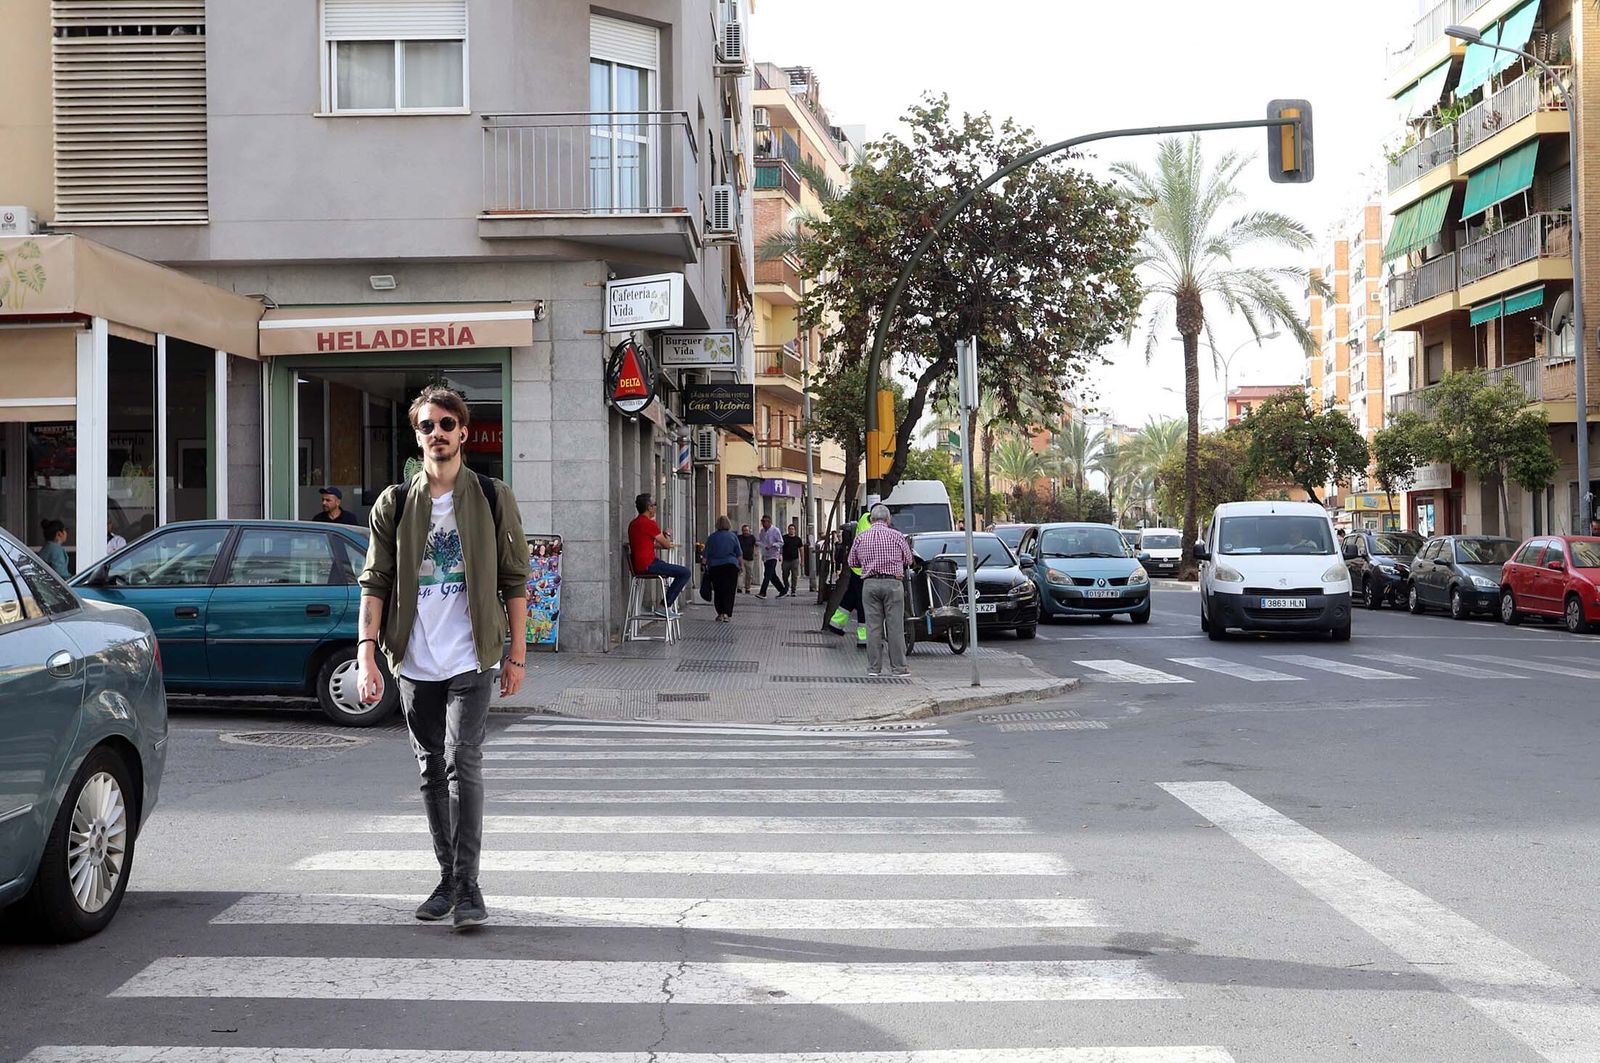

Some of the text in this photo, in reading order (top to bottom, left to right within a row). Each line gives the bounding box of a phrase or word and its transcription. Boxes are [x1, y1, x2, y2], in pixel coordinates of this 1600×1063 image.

[613, 304, 634, 317] Vida
[317, 322, 475, 352] HELADERÍA
[665, 336, 702, 346] Burguer
[674, 346, 694, 355] Vida
[620, 377, 641, 388] DELTA
[688, 399, 751, 411] Casa Victoria
[1267, 599, 1305, 608] 3863 HLN
